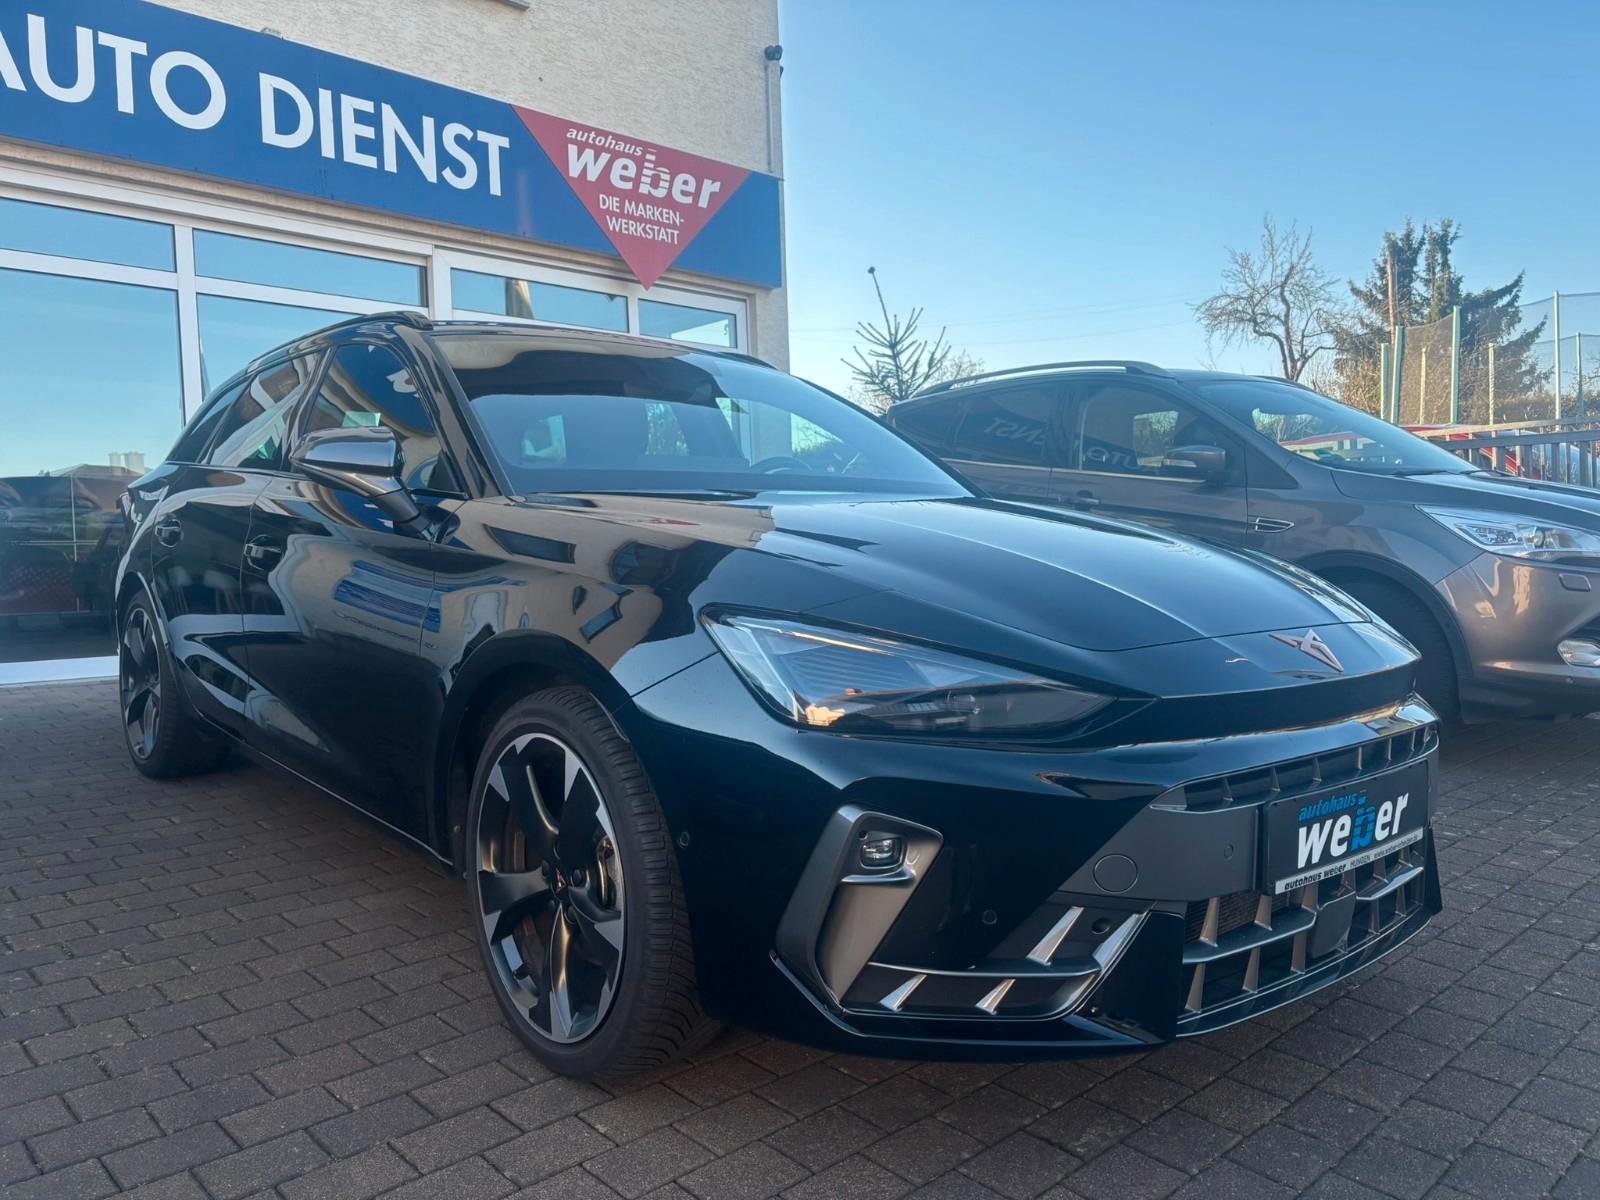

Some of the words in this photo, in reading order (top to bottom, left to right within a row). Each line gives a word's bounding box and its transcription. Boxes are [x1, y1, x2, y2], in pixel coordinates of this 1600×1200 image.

[258, 72, 510, 197] DIENST
[566, 128, 644, 157] autohaus
[567, 143, 721, 209] weber
[599, 193, 620, 213] DIE
[624, 199, 685, 227] MARKEN-
[606, 215, 680, 245] WERKSTATT
[1298, 792, 1358, 821] autohaus
[1297, 790, 1409, 869] weber
[1284, 872, 1322, 891] autohaus
[1323, 863, 1347, 880] weber
